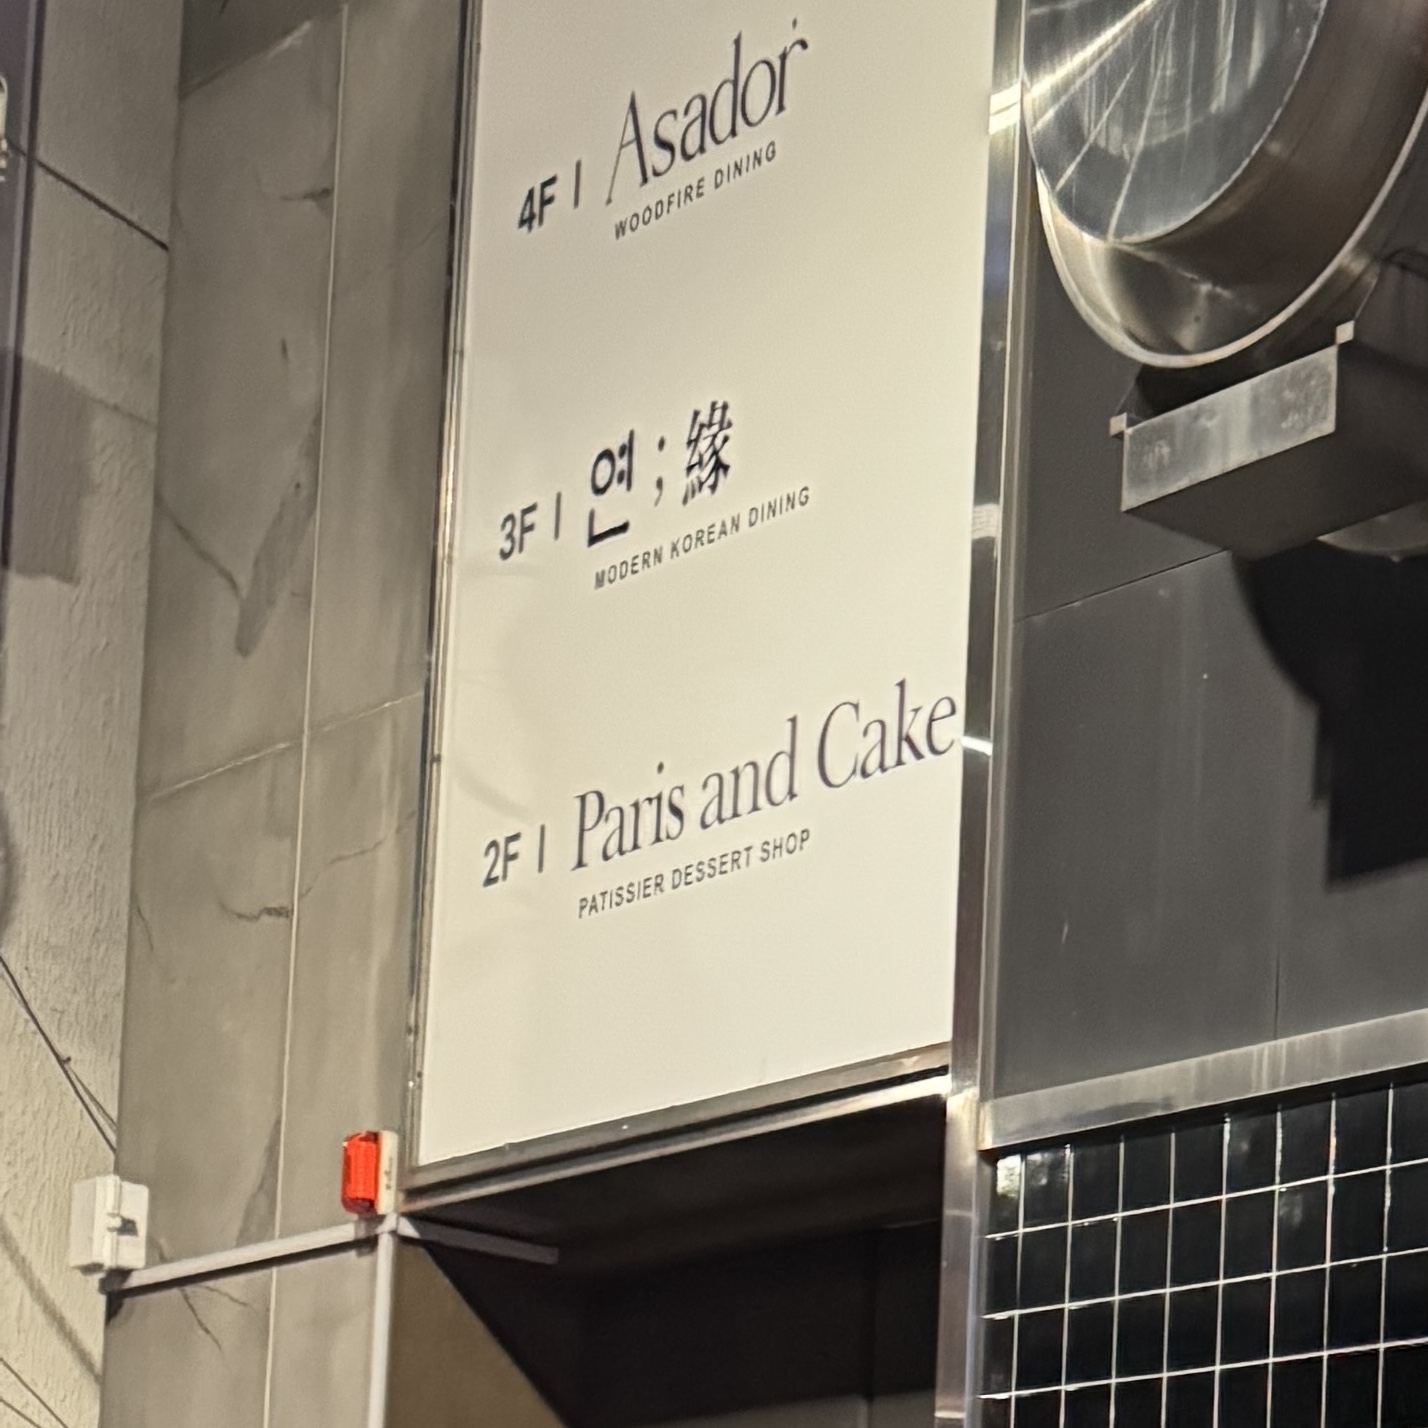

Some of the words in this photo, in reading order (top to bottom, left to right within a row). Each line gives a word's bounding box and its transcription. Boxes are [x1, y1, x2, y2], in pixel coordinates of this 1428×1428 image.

[516, 173, 559, 234] 4F
[613, 177, 706, 241] WOODFIRE
[714, 140, 777, 190] DINING
[499, 502, 539, 561] 3F
[594, 545, 663, 590] MODERN
[670, 513, 741, 560] KOREAN
[749, 486, 811, 529] DINING
[482, 832, 522, 889] 2F
[571, 761, 687, 873] Paris
[699, 714, 799, 831] and
[816, 678, 958, 789] Cake
[577, 875, 665, 920] PATISSIER
[671, 846, 753, 892] DESSERT
[760, 828, 812, 864] SHOP
